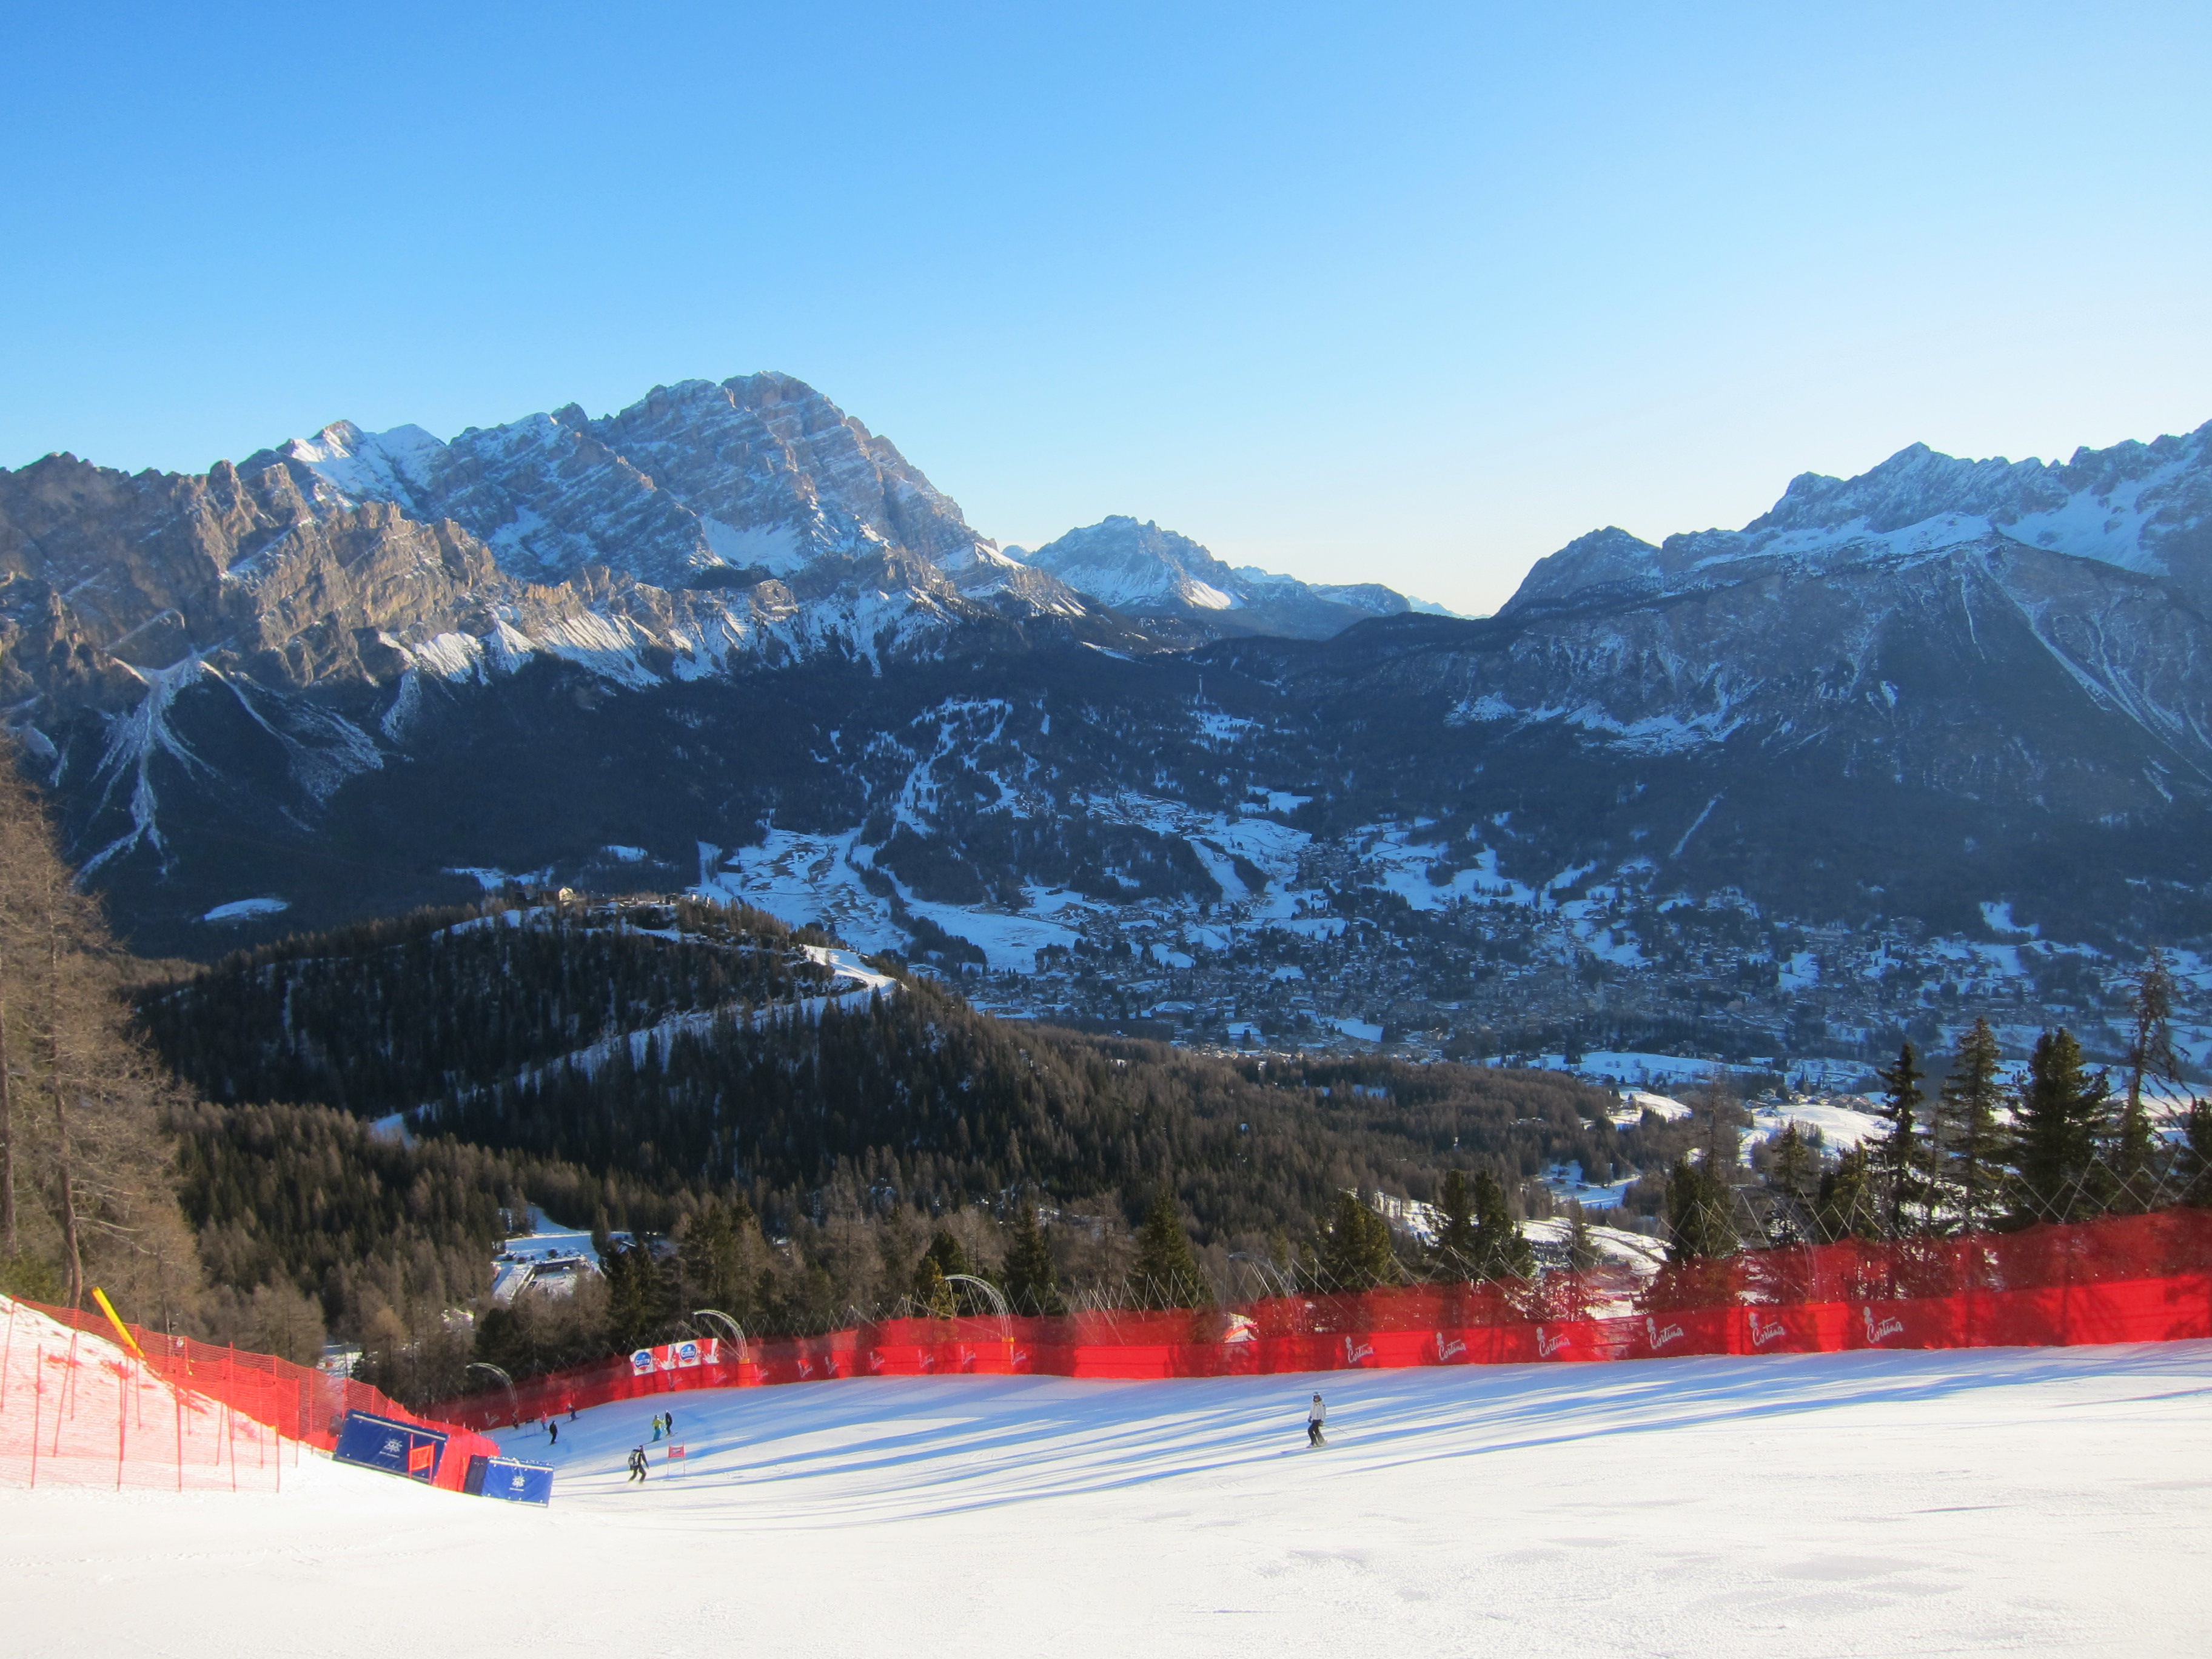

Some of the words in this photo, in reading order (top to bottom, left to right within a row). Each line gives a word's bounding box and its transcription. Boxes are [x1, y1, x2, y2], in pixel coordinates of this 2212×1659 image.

[1649, 1323, 1684, 1350] Cortina
[1752, 1321, 1785, 1346] Cortina
[1866, 1316, 1903, 1344] Cortina
[1348, 1343, 1374, 1363] Cortina
[1438, 1339, 1467, 1361] Cortina
[1538, 1333, 1570, 1357] Cortina
